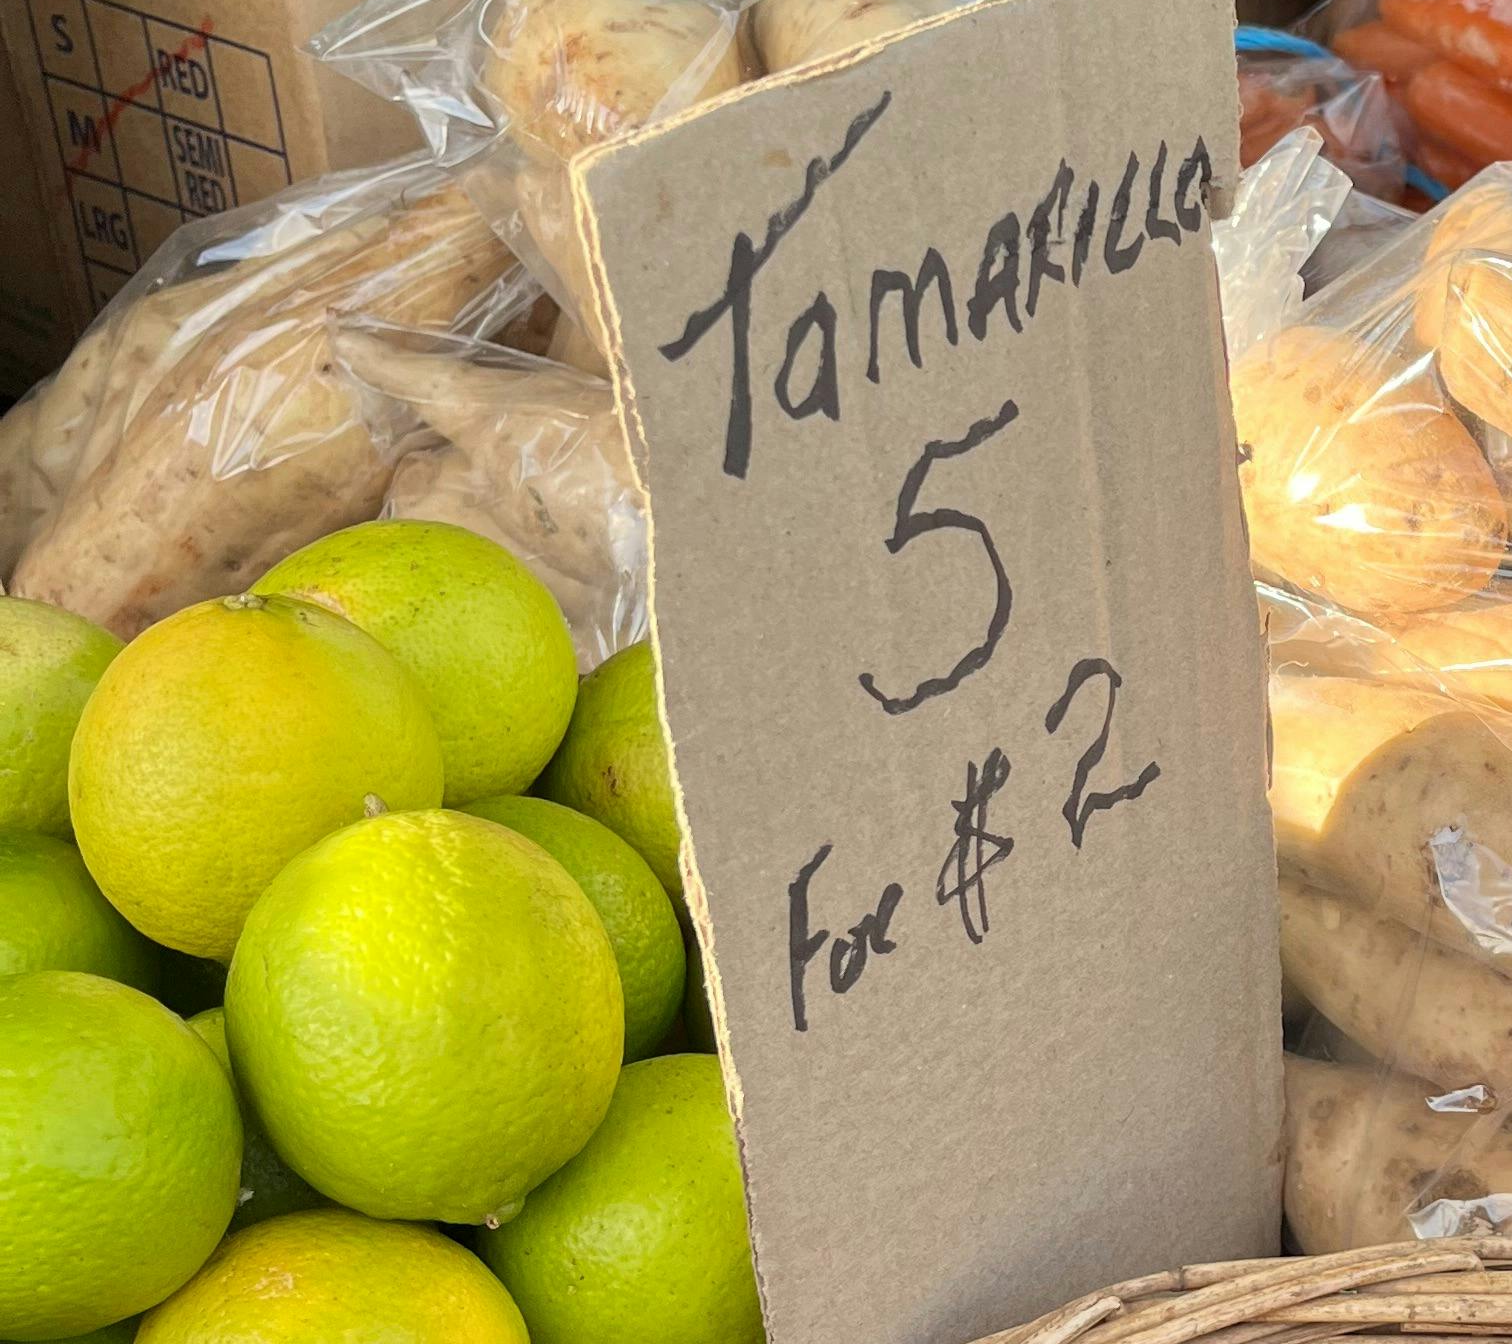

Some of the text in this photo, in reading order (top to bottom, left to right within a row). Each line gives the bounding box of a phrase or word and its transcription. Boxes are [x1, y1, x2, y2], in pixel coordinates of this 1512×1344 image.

[50, 13, 75, 54] S
[156, 47, 210, 100] RED
[66, 108, 102, 153] M
[172, 124, 226, 179] SEMI
[184, 169, 228, 215] RED
[76, 198, 131, 250] LRG
[857, 398, 1020, 716] 5
